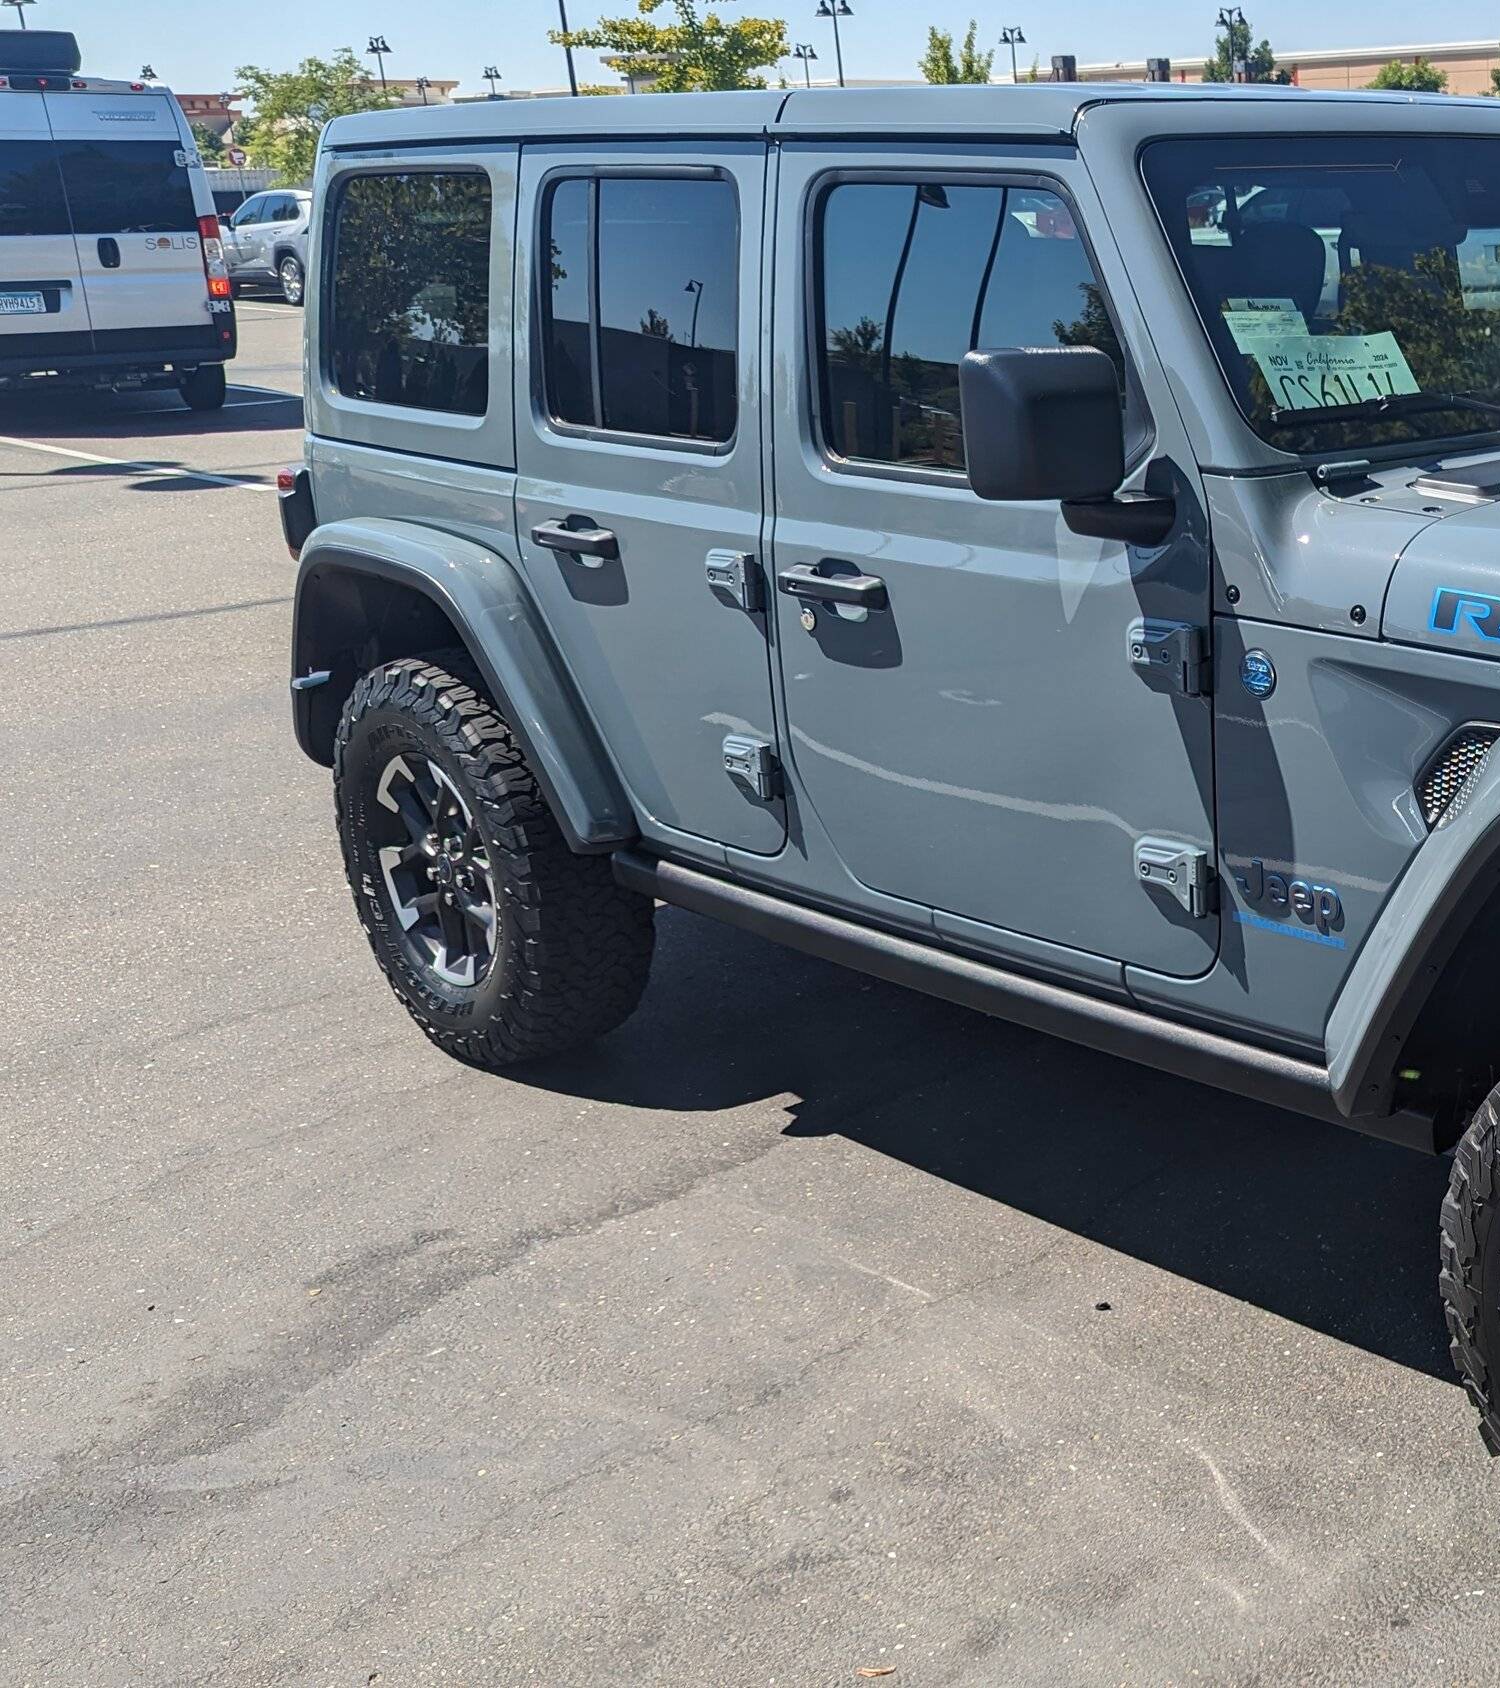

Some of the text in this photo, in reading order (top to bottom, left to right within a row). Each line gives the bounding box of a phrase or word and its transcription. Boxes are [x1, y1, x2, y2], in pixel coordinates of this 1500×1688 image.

[1268, 355, 1288, 367] NOV
[1306, 352, 1355, 371] California
[1236, 859, 1339, 936] Jeep
